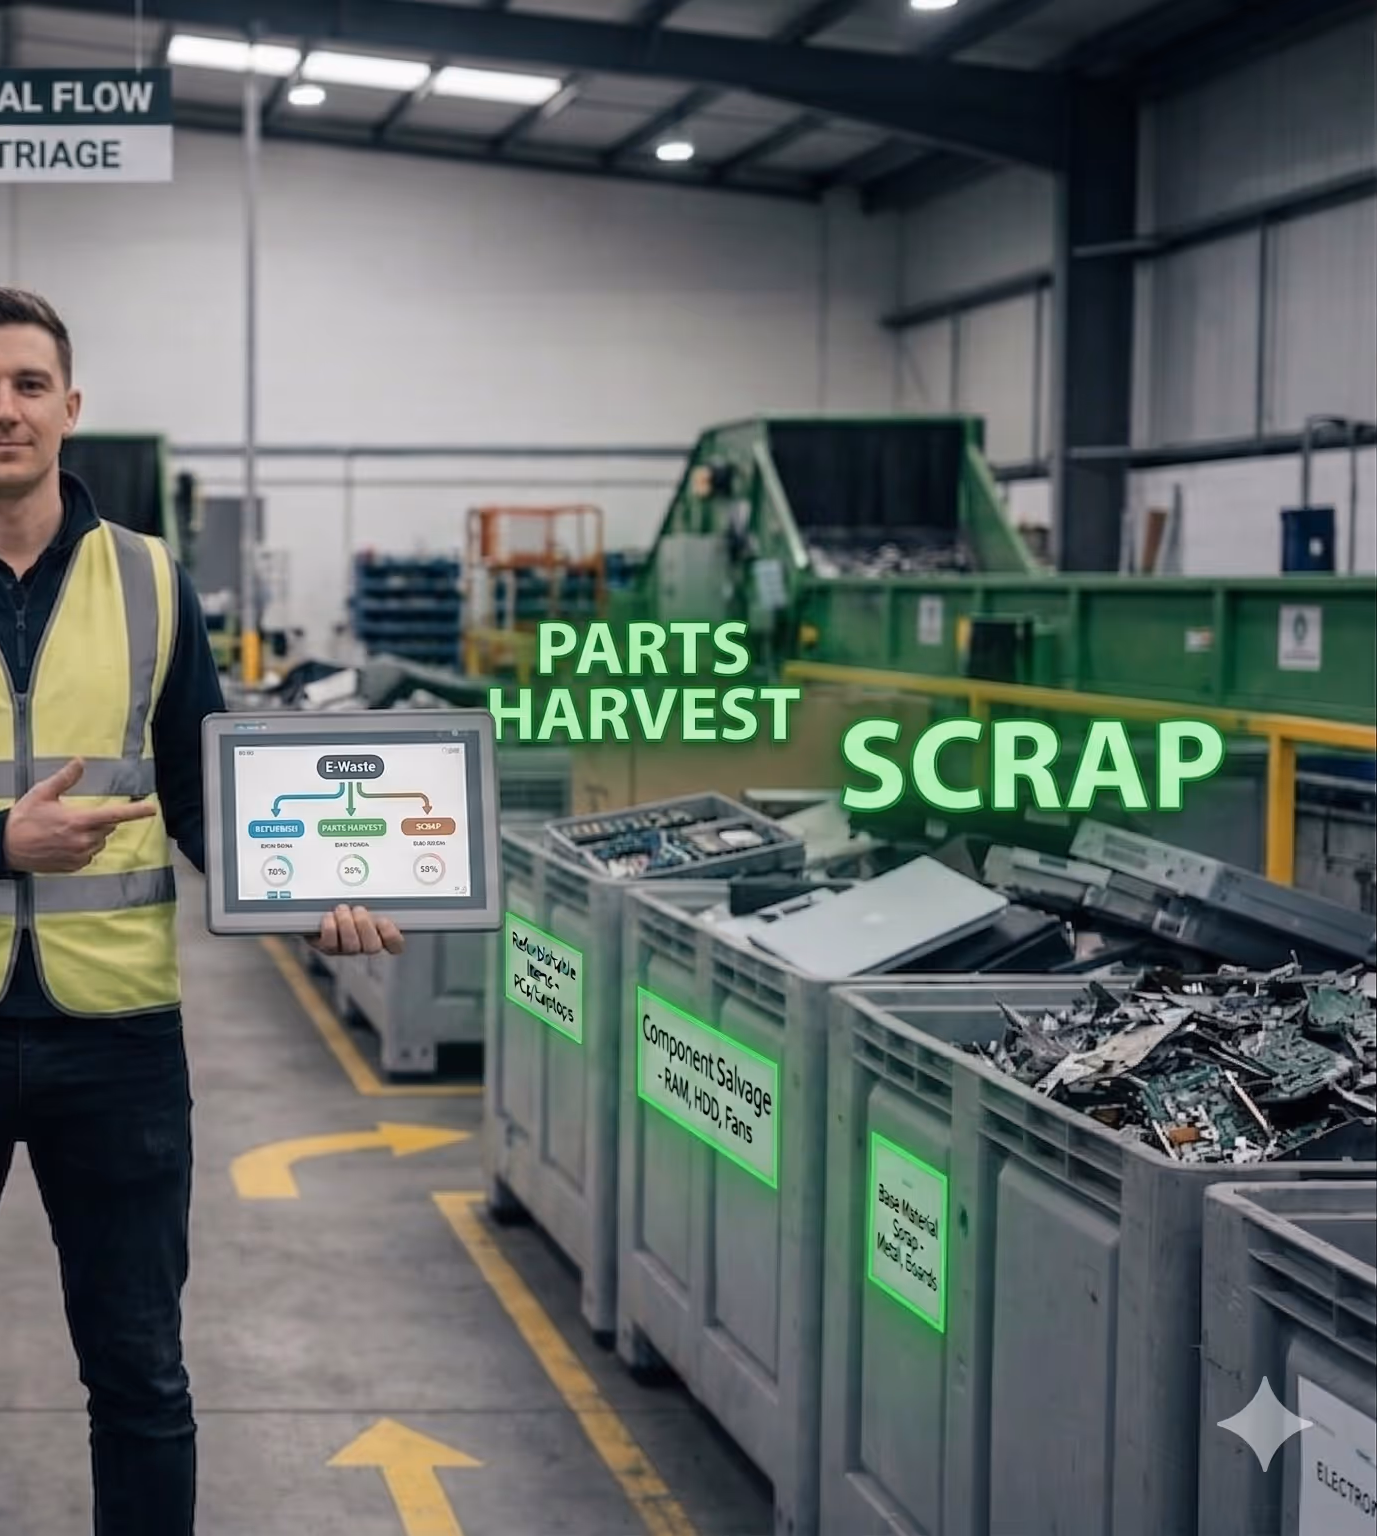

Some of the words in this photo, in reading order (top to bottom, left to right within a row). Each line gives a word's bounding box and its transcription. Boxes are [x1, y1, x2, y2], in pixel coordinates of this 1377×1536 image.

[52, 81, 153, 113] FLOW
[325, 760, 376, 773] E-Waste
[643, 1014, 715, 1081] Component
[716, 1058, 772, 1118] Salvage
[664, 1067, 692, 1110] RAM,
[694, 1085, 723, 1129] HDD,
[725, 1105, 753, 1144] Fans
